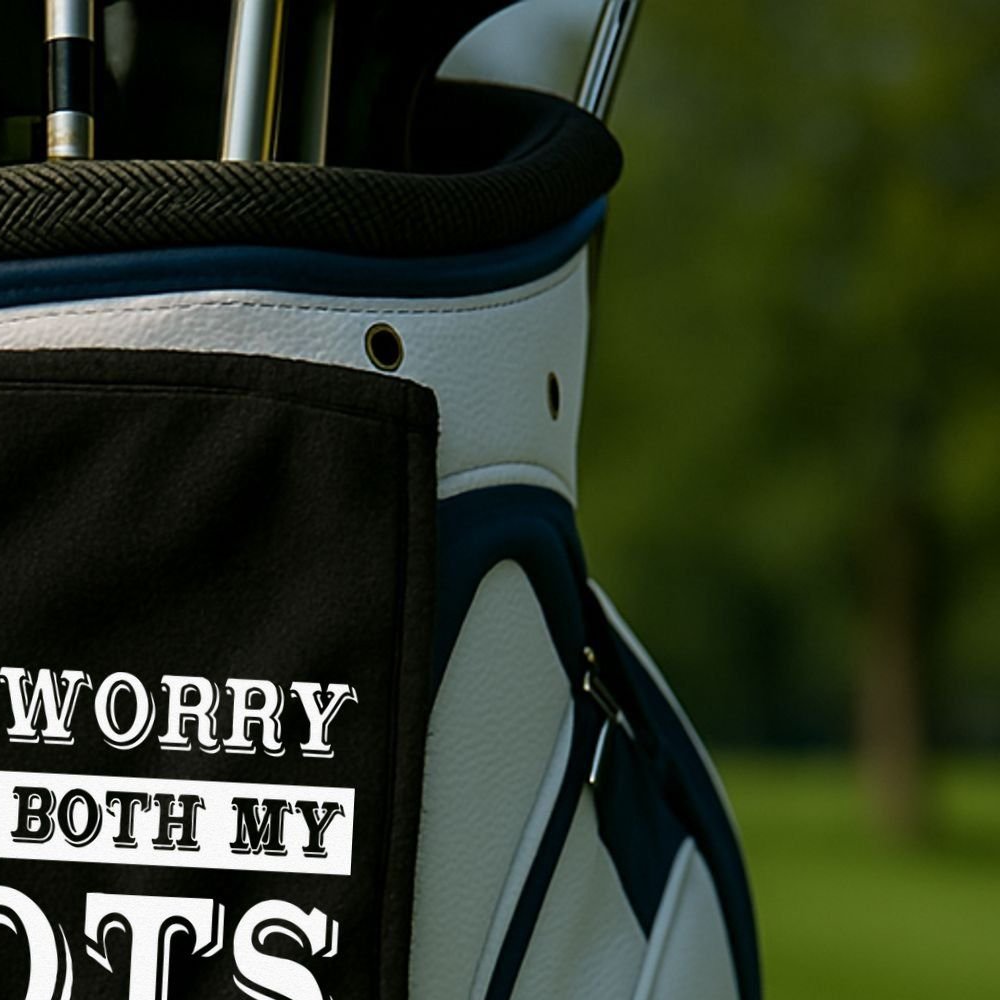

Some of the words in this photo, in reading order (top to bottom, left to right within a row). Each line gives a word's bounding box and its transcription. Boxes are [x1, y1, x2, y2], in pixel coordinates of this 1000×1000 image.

[0, 667, 358, 758] WORRY
[11, 786, 205, 851] BOTH
[230, 797, 345, 858] MY
